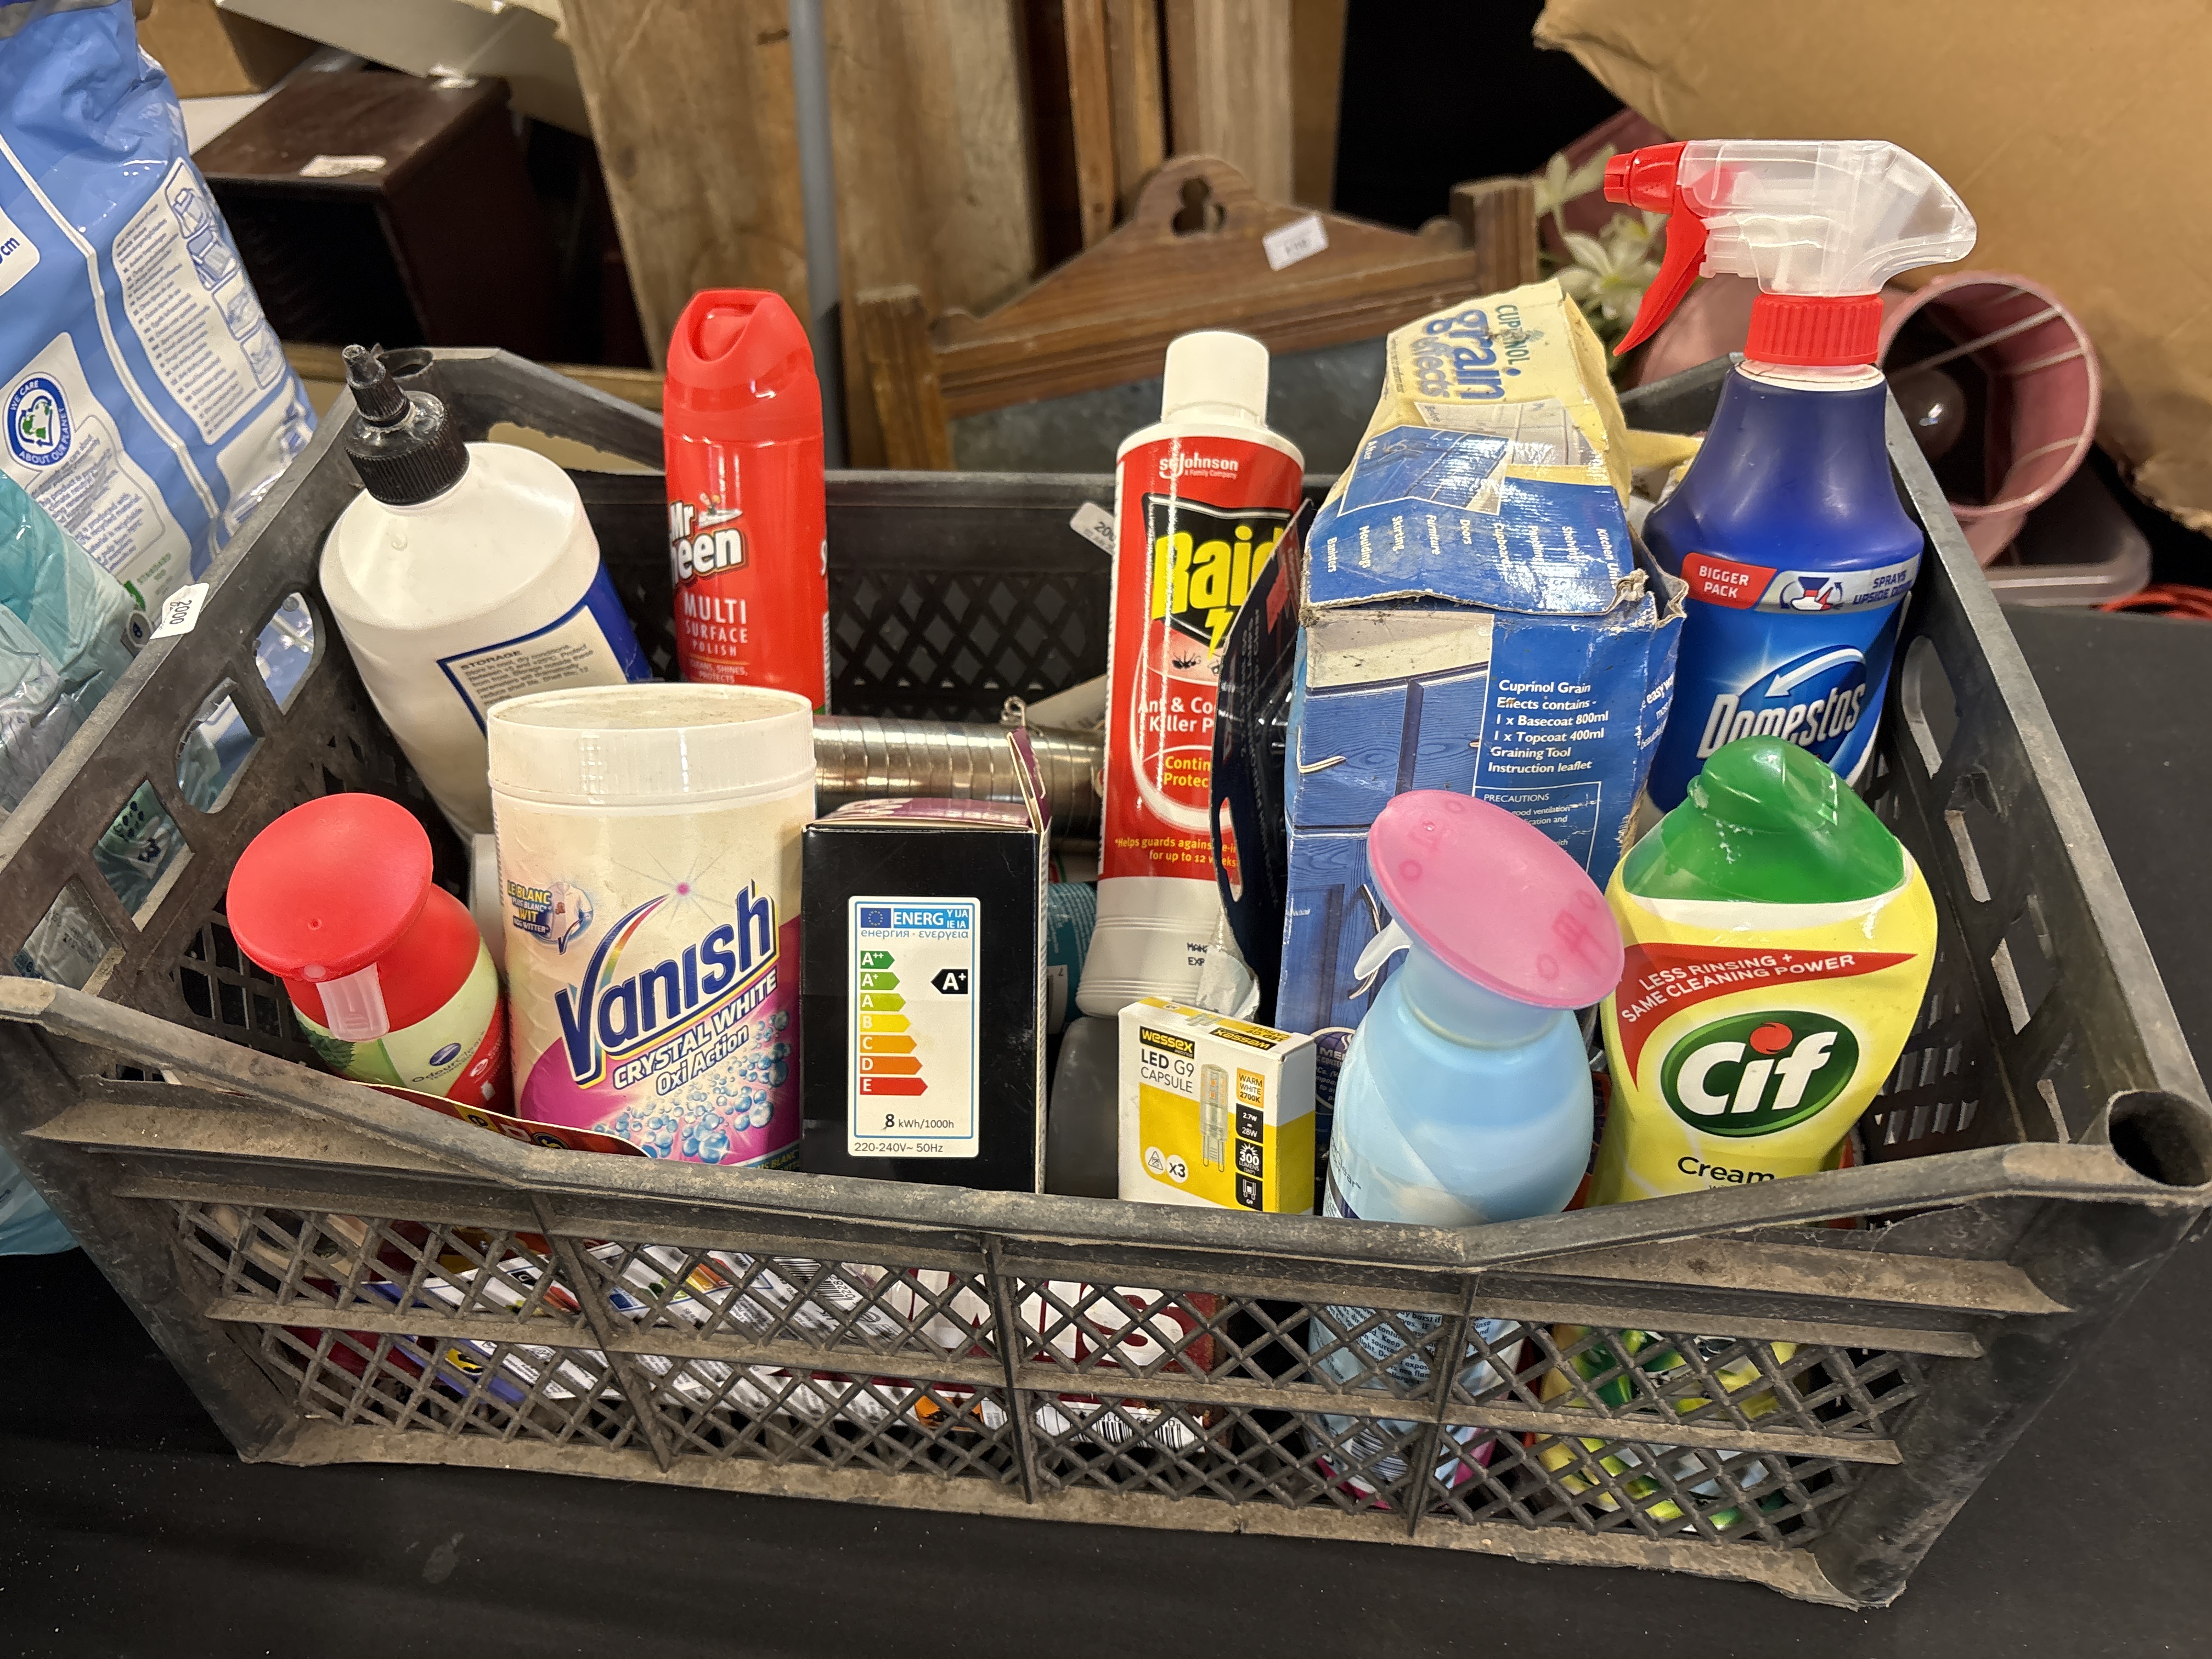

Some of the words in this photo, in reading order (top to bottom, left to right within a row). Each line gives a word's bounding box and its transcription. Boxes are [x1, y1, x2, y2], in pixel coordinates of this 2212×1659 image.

[0, 238, 20, 264] cm
[1496, 304, 1531, 365] CUPNOL
[1426, 309, 1521, 399] grain
[10, 396, 20, 410] WE
[20, 380, 39, 396] CARE
[19, 452, 50, 464] ABOUT
[52, 444, 66, 460] OUR
[59, 408, 70, 444] PLANET
[670, 501, 694, 540] Mr
[1094, 521, 1114, 541] 20
[1391, 516, 1404, 550] Skirting
[1426, 514, 1440, 555] Furniture
[1459, 519, 1471, 545] Doors
[1358, 525, 1370, 568] Mouldings
[1493, 523, 1510, 565] Cupboard
[1596, 528, 1614, 561] Kitchen
[671, 528, 742, 588] een
[1326, 537, 1337, 573] Banisters
[1699, 566, 1750, 586] BIGGER
[1873, 569, 1908, 589] SPRAYS
[1703, 581, 1739, 599] PACK
[1853, 588, 1890, 605] UPSIDE
[170, 600, 192, 625] 2000
[684, 591, 746, 624] MULTI
[686, 619, 748, 644] SURFACE
[692, 640, 737, 657] POLISH
[460, 651, 522, 670] STORAGE
[1498, 680, 1554, 695] Cuprinol
[1558, 682, 1591, 694] Grain
[1646, 684, 1664, 704] easy
[1138, 698, 1166, 713] An
[1171, 697, 1186, 712] &
[1190, 697, 1216, 714] Co
[1497, 697, 1539, 710] Effects
[1542, 699, 1590, 711] contains
[1149, 714, 1198, 732] Kller
[1518, 716, 1573, 726] Basecoat
[1576, 711, 1609, 725] 800ml
[1696, 684, 1866, 759] Domestos
[1503, 733, 1512, 742] x
[1516, 731, 1567, 744] Topcoat
[1570, 727, 1605, 741] 400ml
[1491, 747, 1544, 760] Graining
[1546, 747, 1571, 758] Tool
[1165, 756, 1211, 771] Contin
[1488, 762, 1554, 774] Instruction
[1558, 760, 1593, 772] leaflet
[1164, 772, 1209, 788] Protec
[1483, 793, 1550, 803] PRECAUTIONS
[1533, 806, 1571, 815] ventilation
[1142, 837, 1176, 848] guards
[1178, 839, 1212, 850] agains
[1149, 849, 1164, 860] for
[1165, 853, 1178, 862] up
[1182, 852, 1192, 861] to
[1195, 855, 1205, 863] 12
[507, 881, 516, 895] LE
[517, 885, 551, 904] BLANC
[518, 908, 538, 922] WIT
[894, 912, 944, 926] ENERG
[861, 929, 910, 939] енергия
[918, 930, 969, 940] ενεργεια
[1188, 957, 1205, 967] EXP
[555, 881, 774, 1079] Vanish
[861, 973, 879, 987] A+
[943, 972, 967, 991] A+
[1639, 967, 1686, 991] LESS
[1691, 955, 1776, 975] RINSING
[1621, 995, 1668, 1023] SAME
[1672, 967, 1771, 998] CLEANING
[1776, 955, 1856, 976] POWER
[861, 996, 874, 1008] A
[613, 1025, 711, 1090] CRYSTAL
[714, 968, 778, 1035] WHITE
[862, 1017, 873, 1029] B
[862, 1037, 873, 1050] C
[1142, 1029, 1193, 1053] wessex
[1214, 1030, 1270, 1050] wessex
[656, 1063, 689, 1096] Oxi
[690, 1025, 749, 1081] Action
[862, 1058, 873, 1070] D
[1141, 1048, 1169, 1069] LED
[1174, 1059, 1194, 1077] G9
[1677, 1022, 1838, 1116] Cif
[862, 1079, 872, 1092] E
[1141, 1066, 1193, 1093] CAPSULE
[1239, 1073, 1262, 1087] WARM
[1239, 1082, 1261, 1096] WHITE
[1239, 1091, 1261, 1104] 2700K
[884, 1114, 895, 1128] 8
[899, 1118, 954, 1129] kWh/1000h
[1243, 1112, 1258, 1122] 2.7W
[1242, 1127, 1258, 1138] 28W
[916, 1142, 943, 1153] 50Hz
[1239, 1160, 1260, 1172] LUMENS
[1240, 1151, 1260, 1166] 300
[1677, 1156, 1775, 1184] Cream
[1382, 1335, 1400, 1348] Keep
